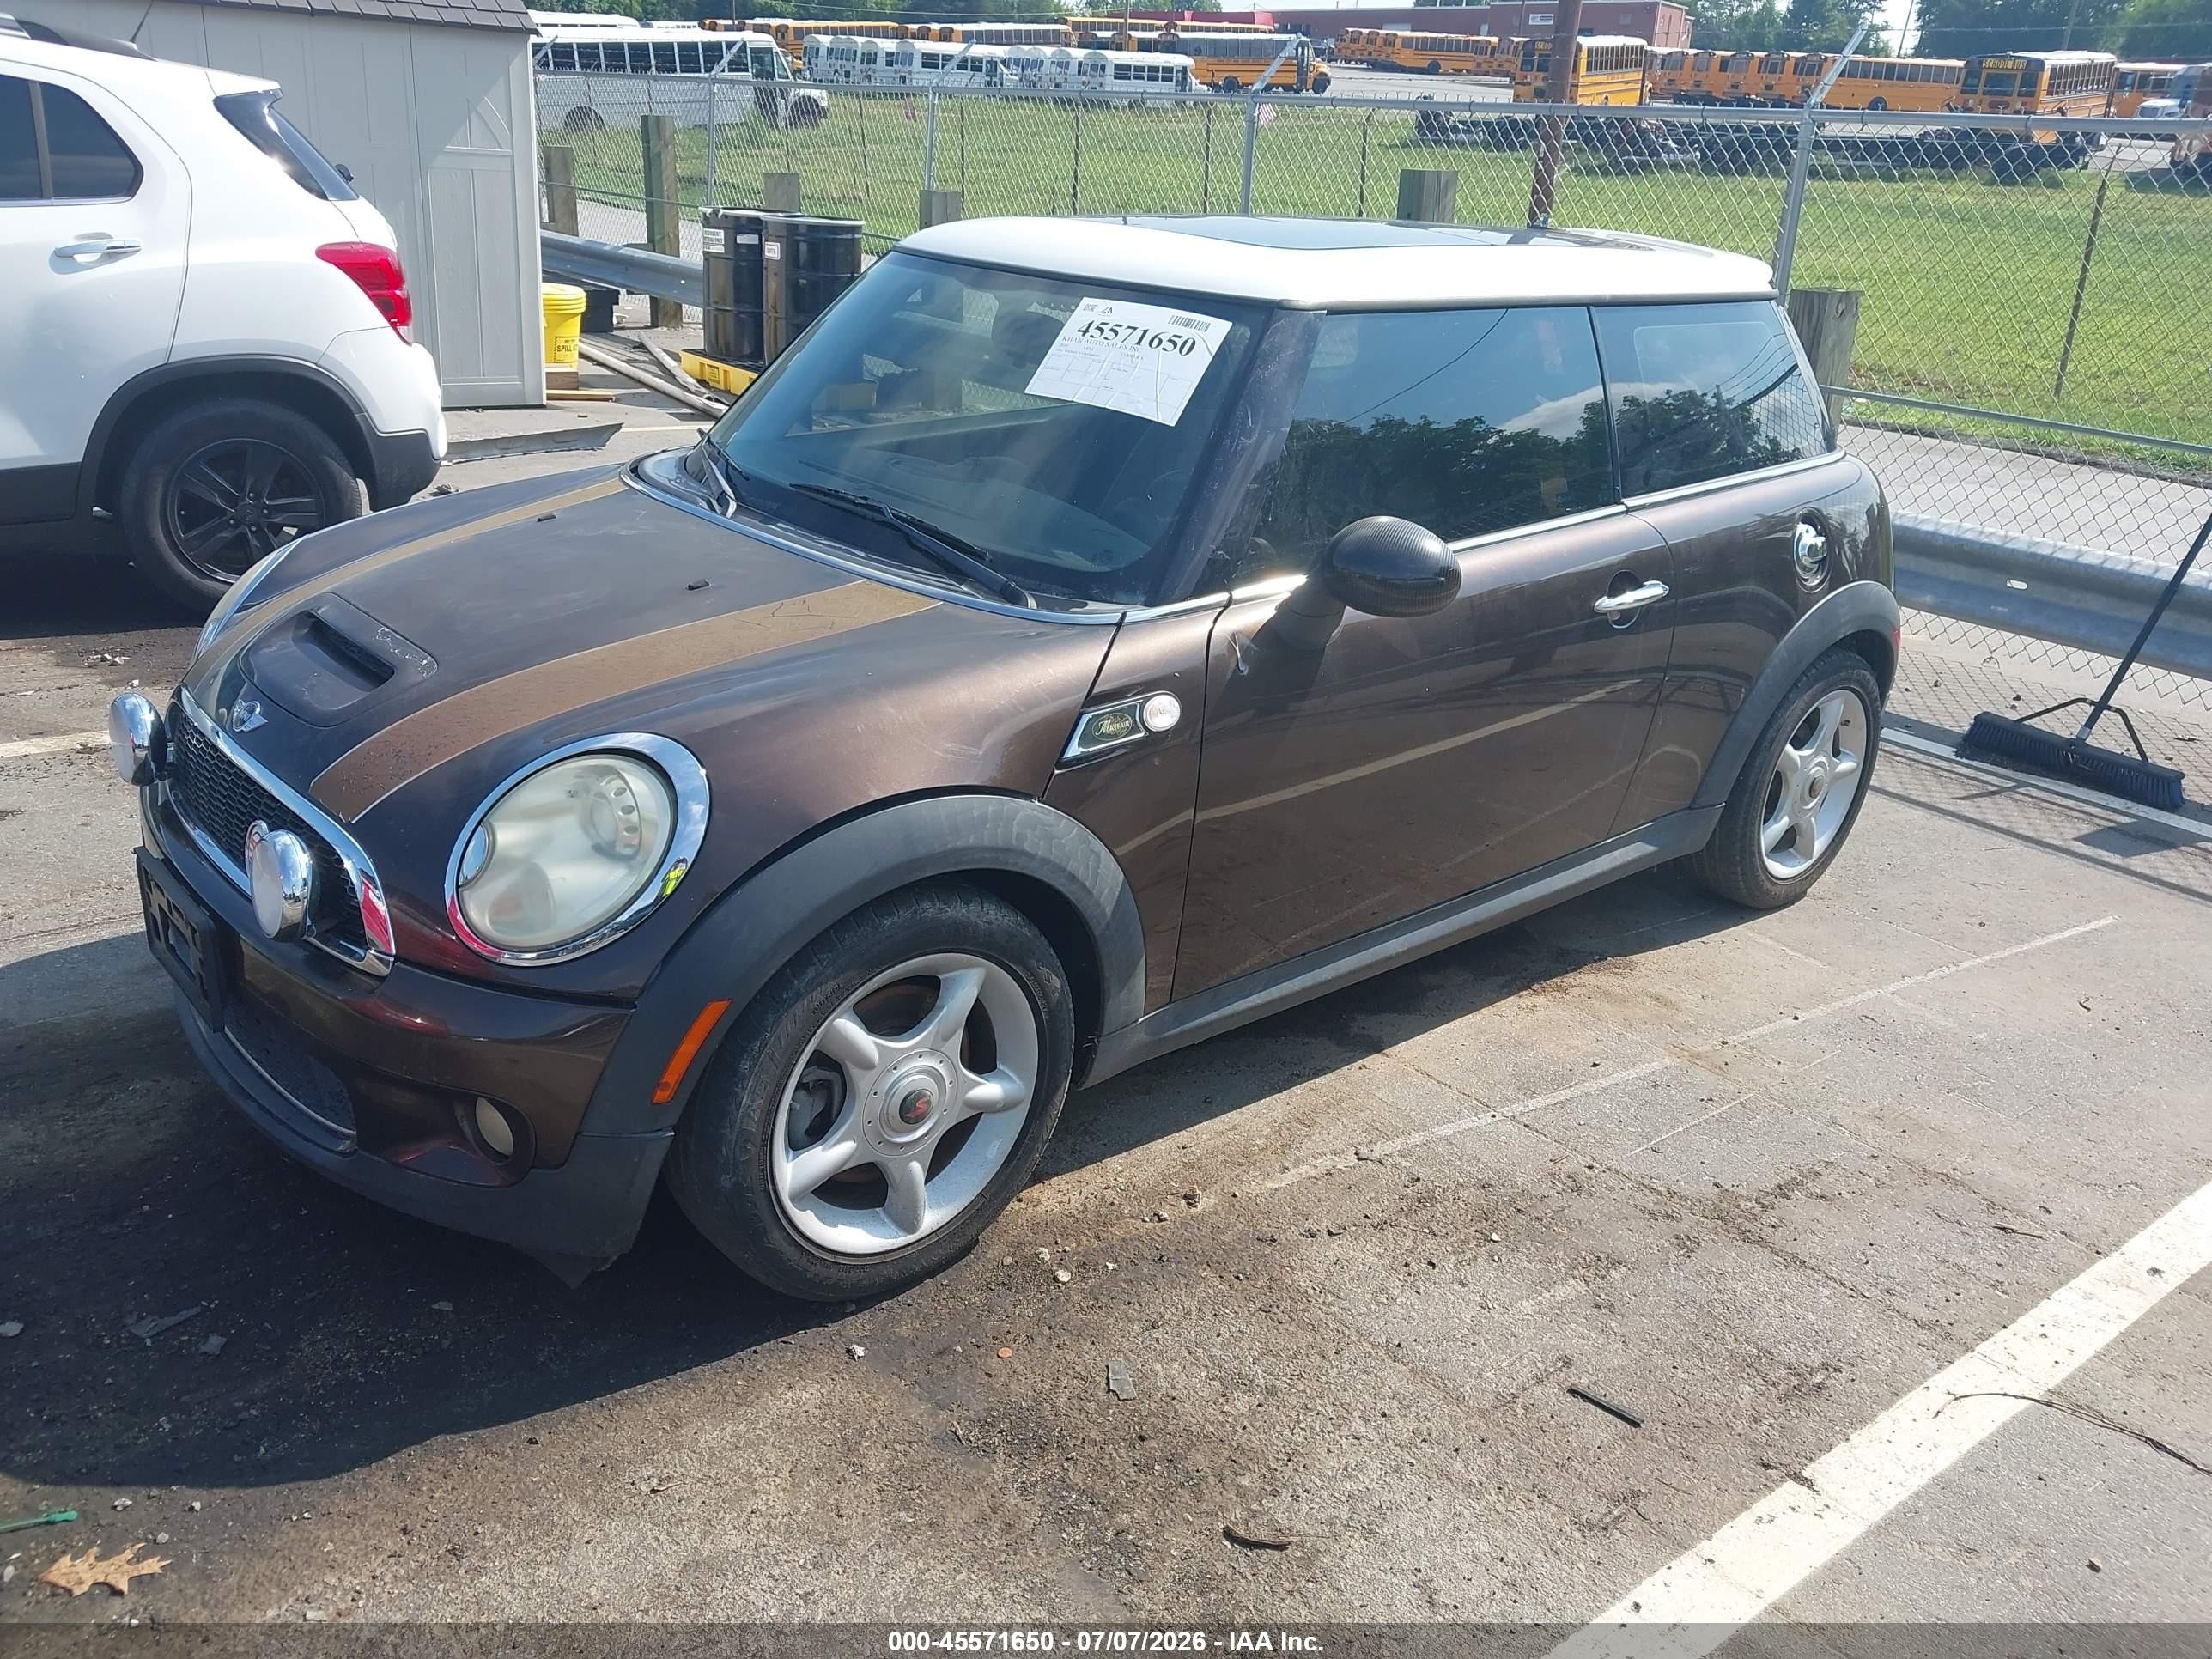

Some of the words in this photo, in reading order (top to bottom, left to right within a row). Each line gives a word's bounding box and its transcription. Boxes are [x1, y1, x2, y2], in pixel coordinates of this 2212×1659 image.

[1983, 59, 2008, 69] SCHOOL
[2010, 59, 2026, 69] BUS
[1077, 319, 1196, 356] 45571650
[1085, 338, 1104, 347] AUTO
[1104, 341, 1127, 351] SALES
